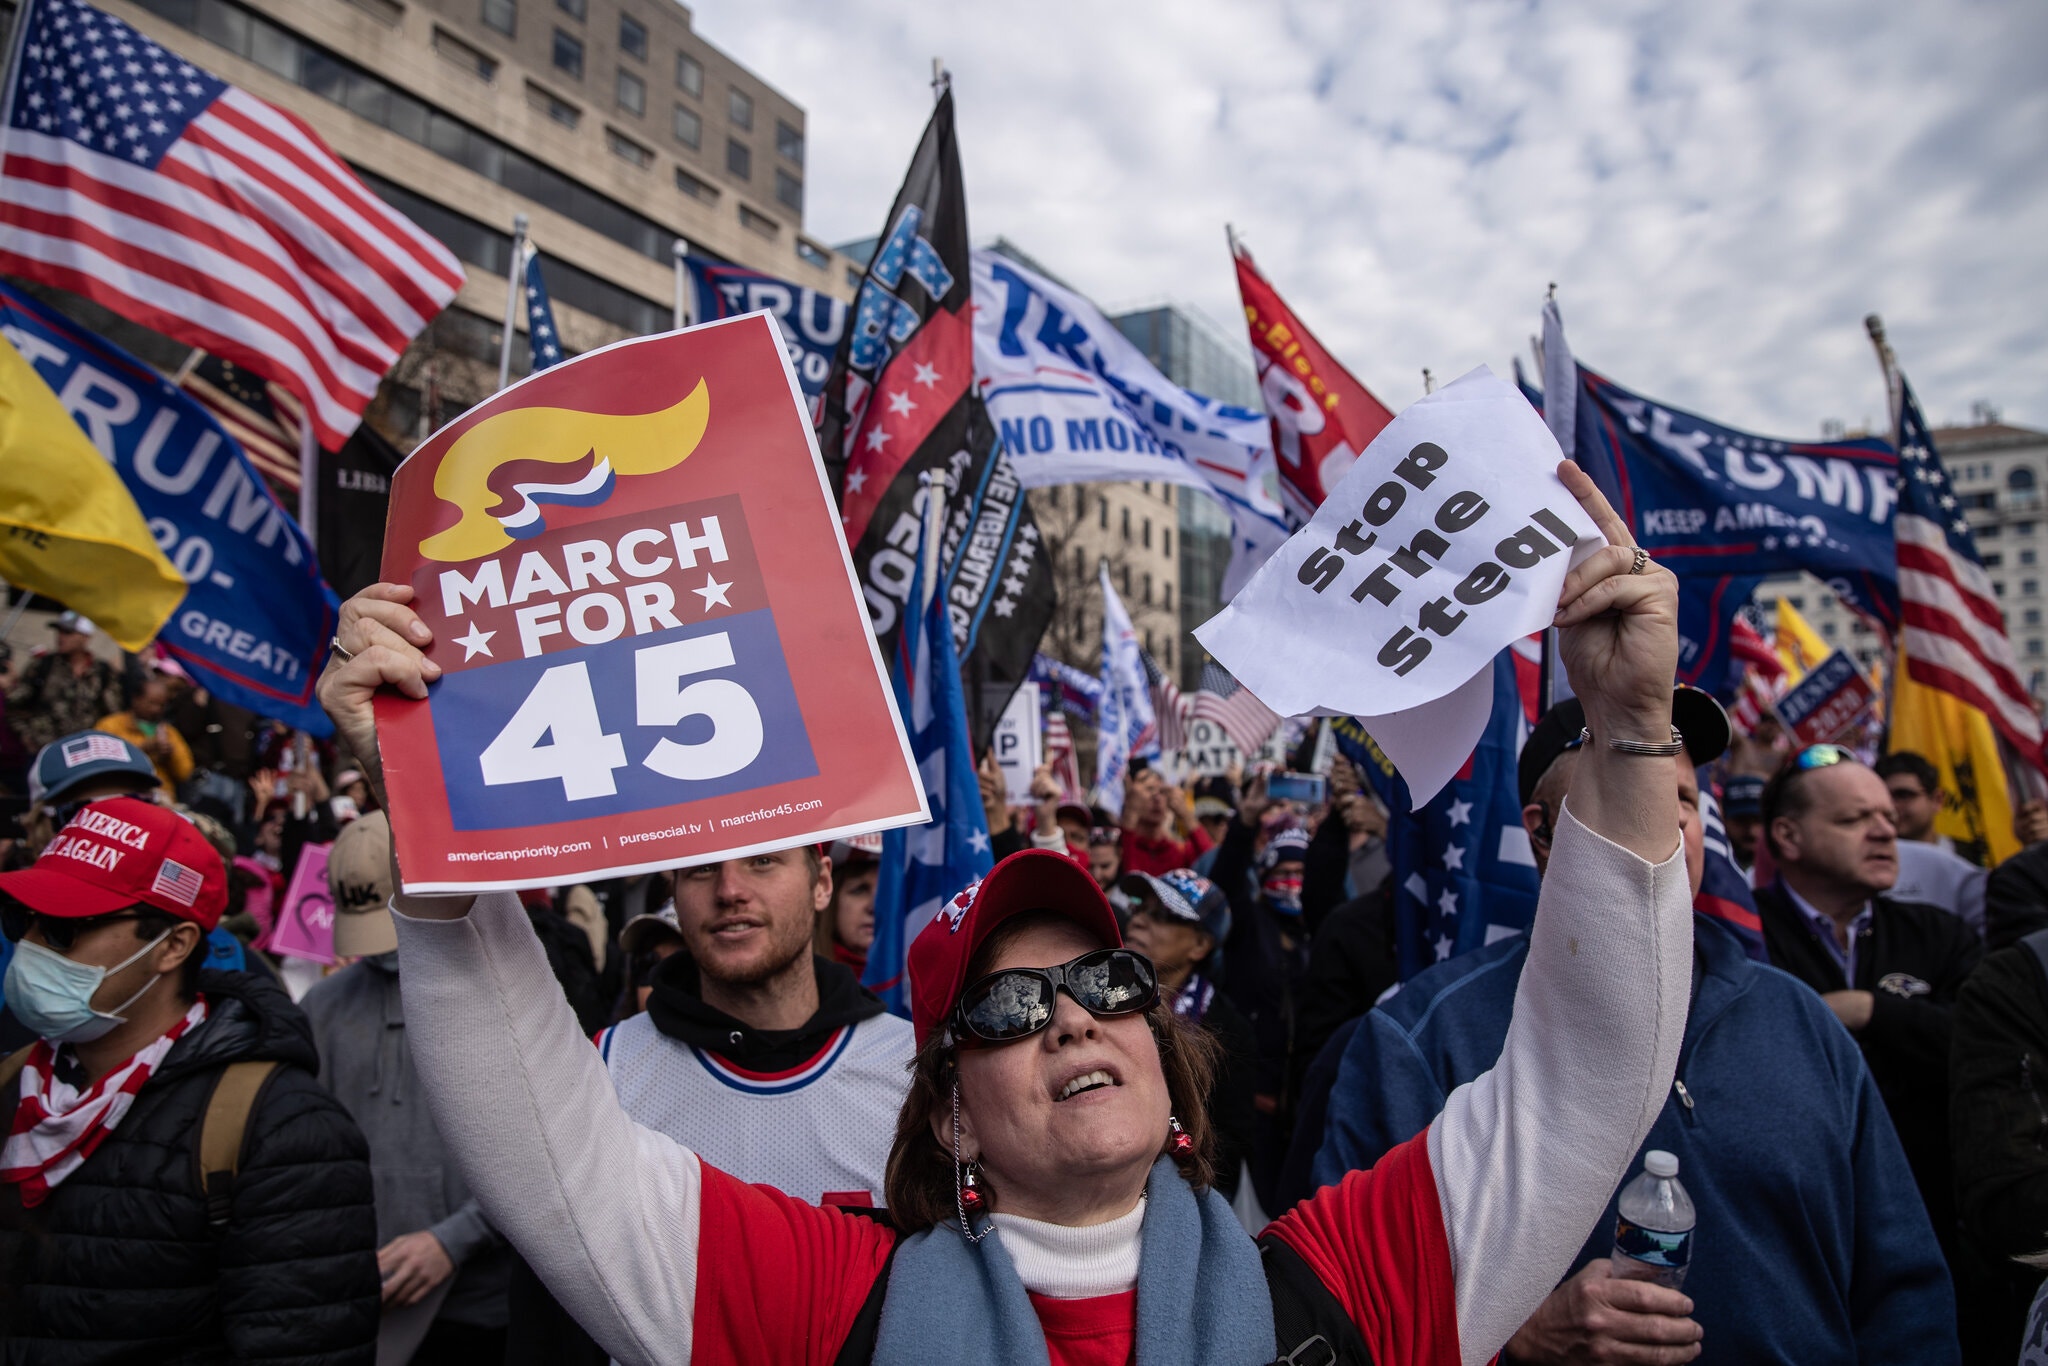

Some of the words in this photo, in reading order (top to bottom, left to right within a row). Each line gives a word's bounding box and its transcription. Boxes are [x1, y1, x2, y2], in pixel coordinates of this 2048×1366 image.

[1001, 416, 1054, 457] NO
[1297, 442, 1449, 593] Stop
[1350, 490, 1490, 607] The
[1643, 509, 1707, 536] KEEP
[439, 516, 730, 617] MARCH
[1377, 507, 1578, 677] Steal
[179, 609, 301, 683] GREAT!
[515, 581, 684, 658] FOR
[479, 631, 764, 802] 45
[56, 836, 127, 873] AGAIN
[447, 840, 592, 863] americanpriority.com
[619, 822, 702, 847] puresocial.tv
[720, 797, 823, 828] marchfor45.com
